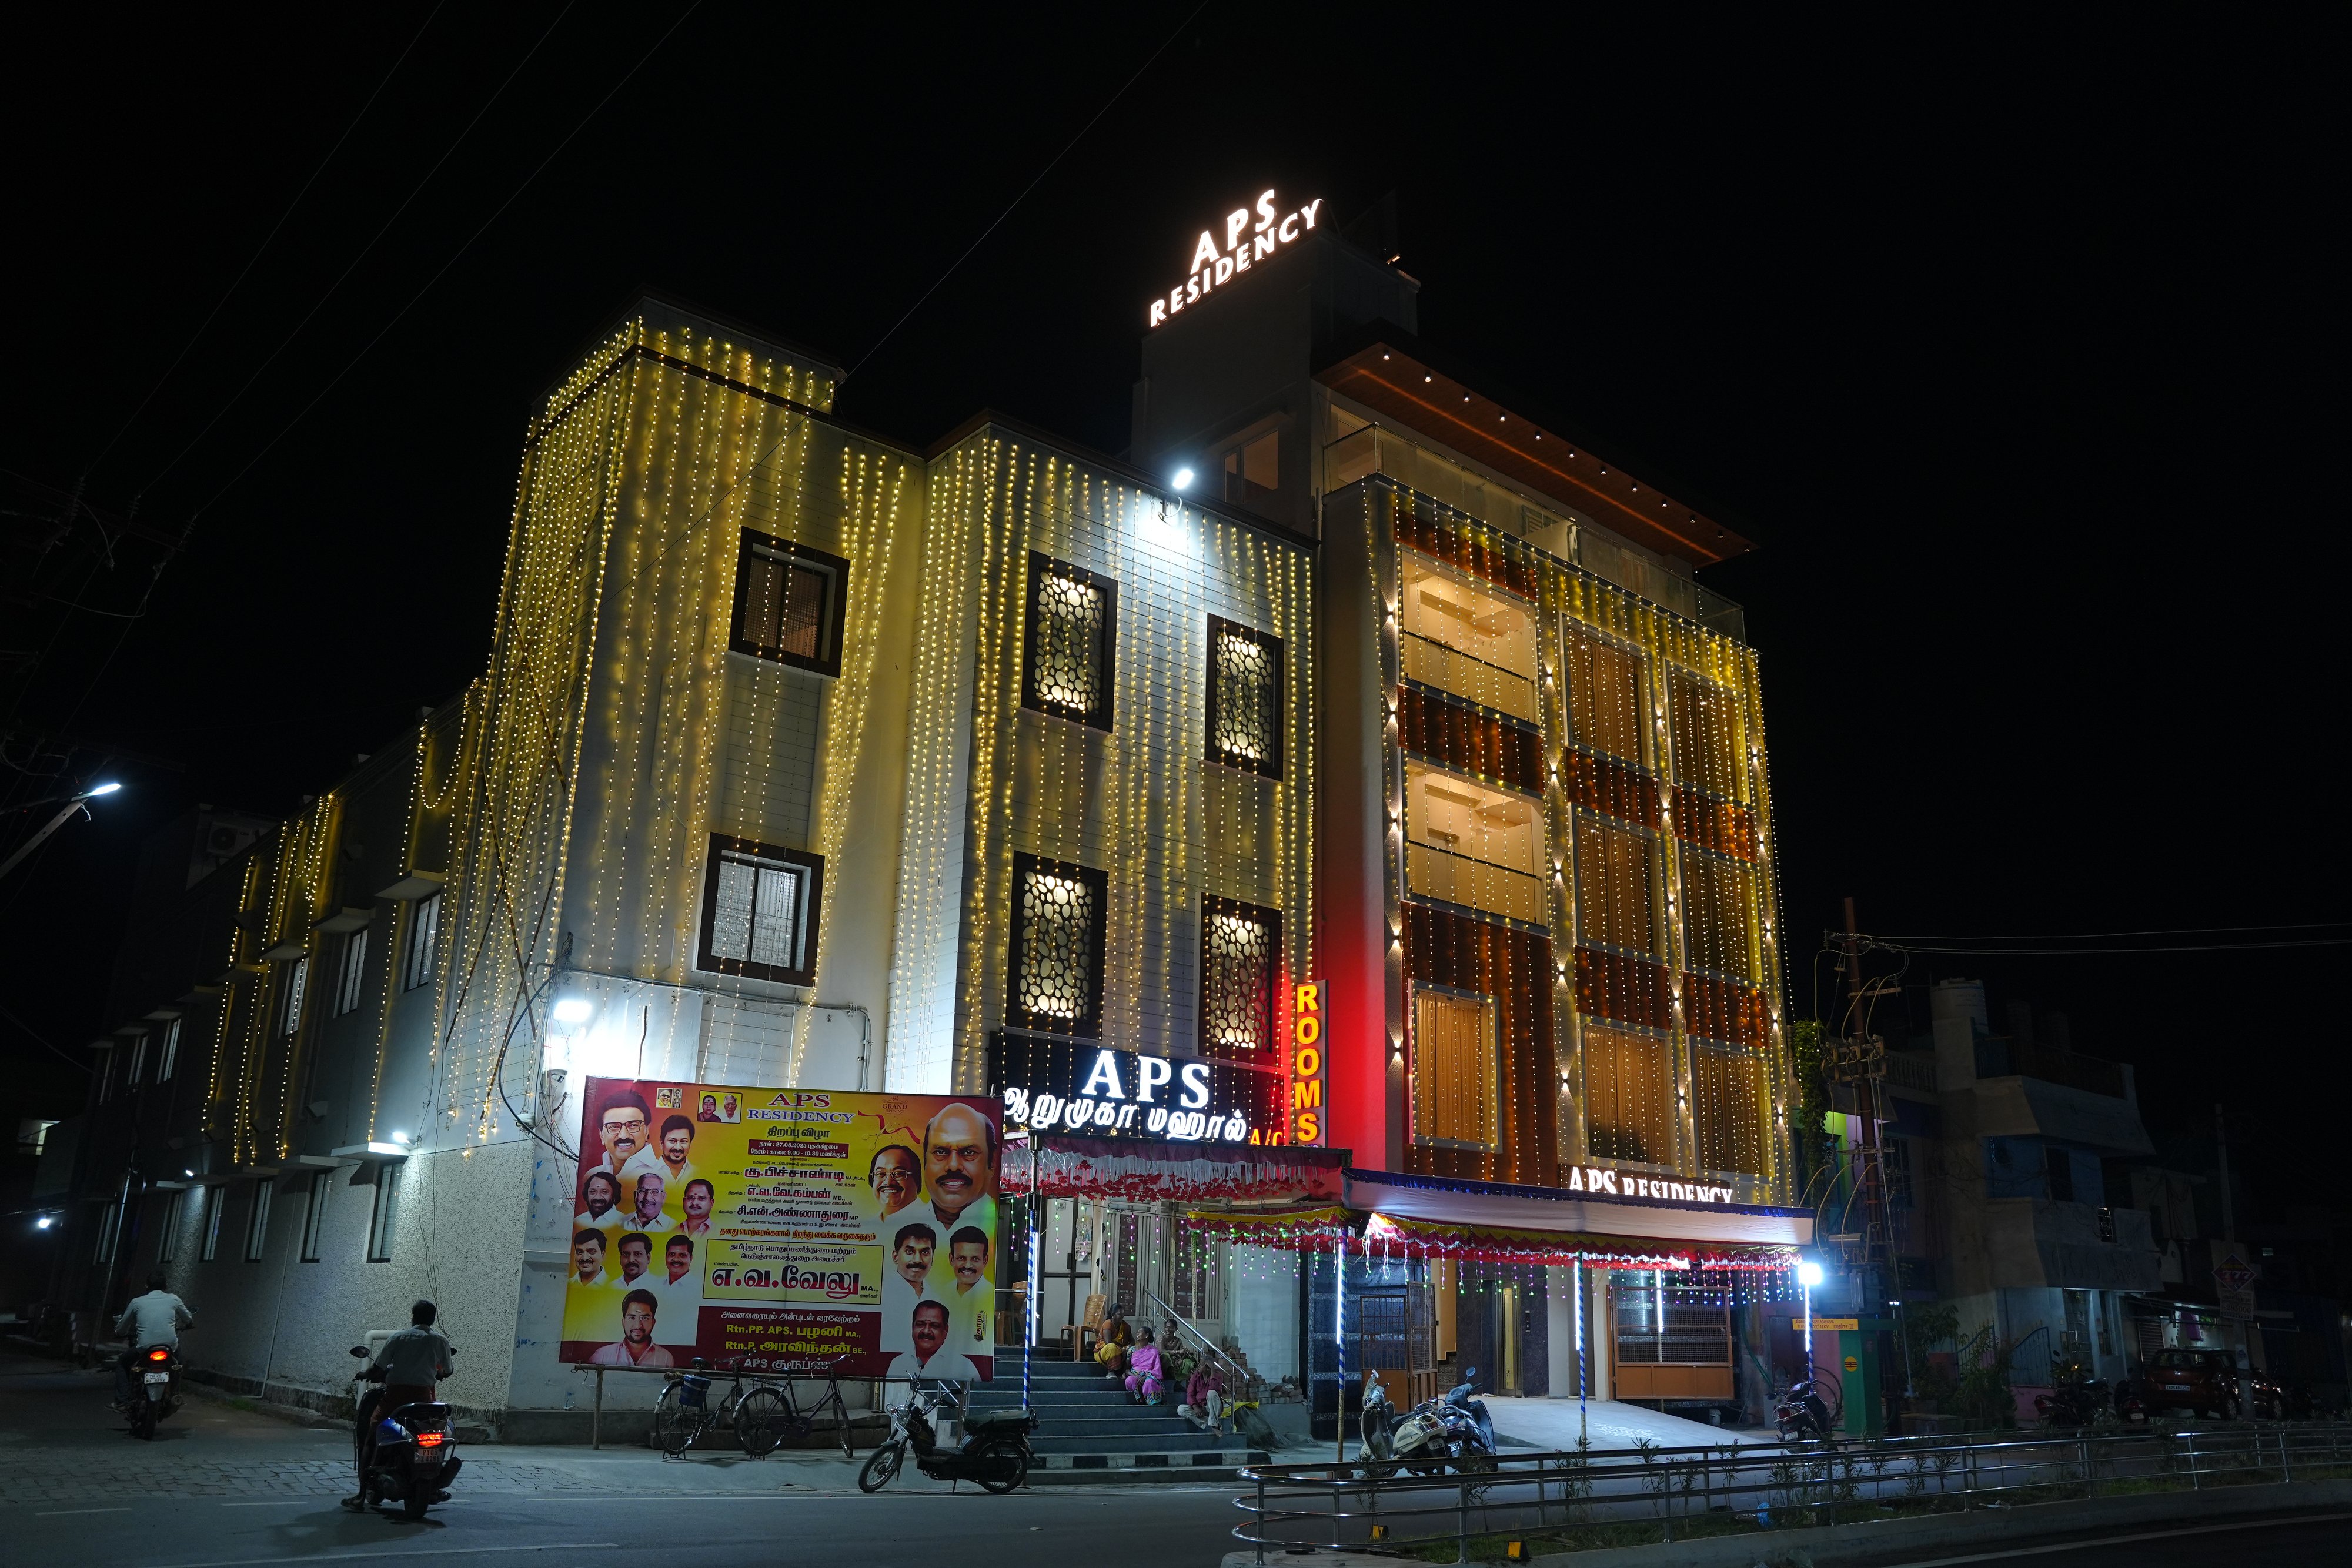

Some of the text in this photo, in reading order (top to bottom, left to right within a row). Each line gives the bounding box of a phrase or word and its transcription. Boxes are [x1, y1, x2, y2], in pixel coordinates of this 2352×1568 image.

[1190, 189, 1276, 275] APS
[1150, 198, 1323, 328] RESIDENCY
[1295, 983, 1321, 1142] ROOMS
[1082, 1049, 1211, 1109] APS
[769, 1093, 830, 1108] APS
[748, 1109, 854, 1123] RESIDENCY
[1004, 1086, 1247, 1141] ஆறுமுகா மஹால்
[767, 1126, 830, 1139] திறப்பு விழா
[744, 1166, 845, 1182] கு.பிச்சாண்டி
[1569, 1166, 1733, 1203] APS RESIDENCY
[747, 1186, 831, 1199] எ.வ.வே.கம்பன்
[737, 1205, 849, 1222] சி.என்.அண்ணாதுரை
[720, 1228, 739, 1236] தனது
[740, 1228, 790, 1238] பொற்கரங்களால்
[792, 1229, 813, 1240] திறந்து
[837, 1232, 876, 1241] வருகைதரும்
[730, 1242, 857, 1256] தமிழ்நாடு பொதுப்பணித்துறை மற்றும்
[741, 1252, 845, 1263] நெடுஞ்சாலைத்துறை அமைச்சர்
[711, 1265, 860, 1299] எ.வ.வேலு
[721, 1310, 860, 1324] அனைவரையும் அன்புடன் வரவேற்கும்
[726, 1325, 764, 1334] Rtn.PP.
[767, 1326, 793, 1335] APS.
[796, 1326, 843, 1339] பழனி
[726, 1341, 756, 1350] Rtn.P.
[759, 1341, 852, 1355] அரவிந்தன்
[744, 1358, 768, 1368] APS
